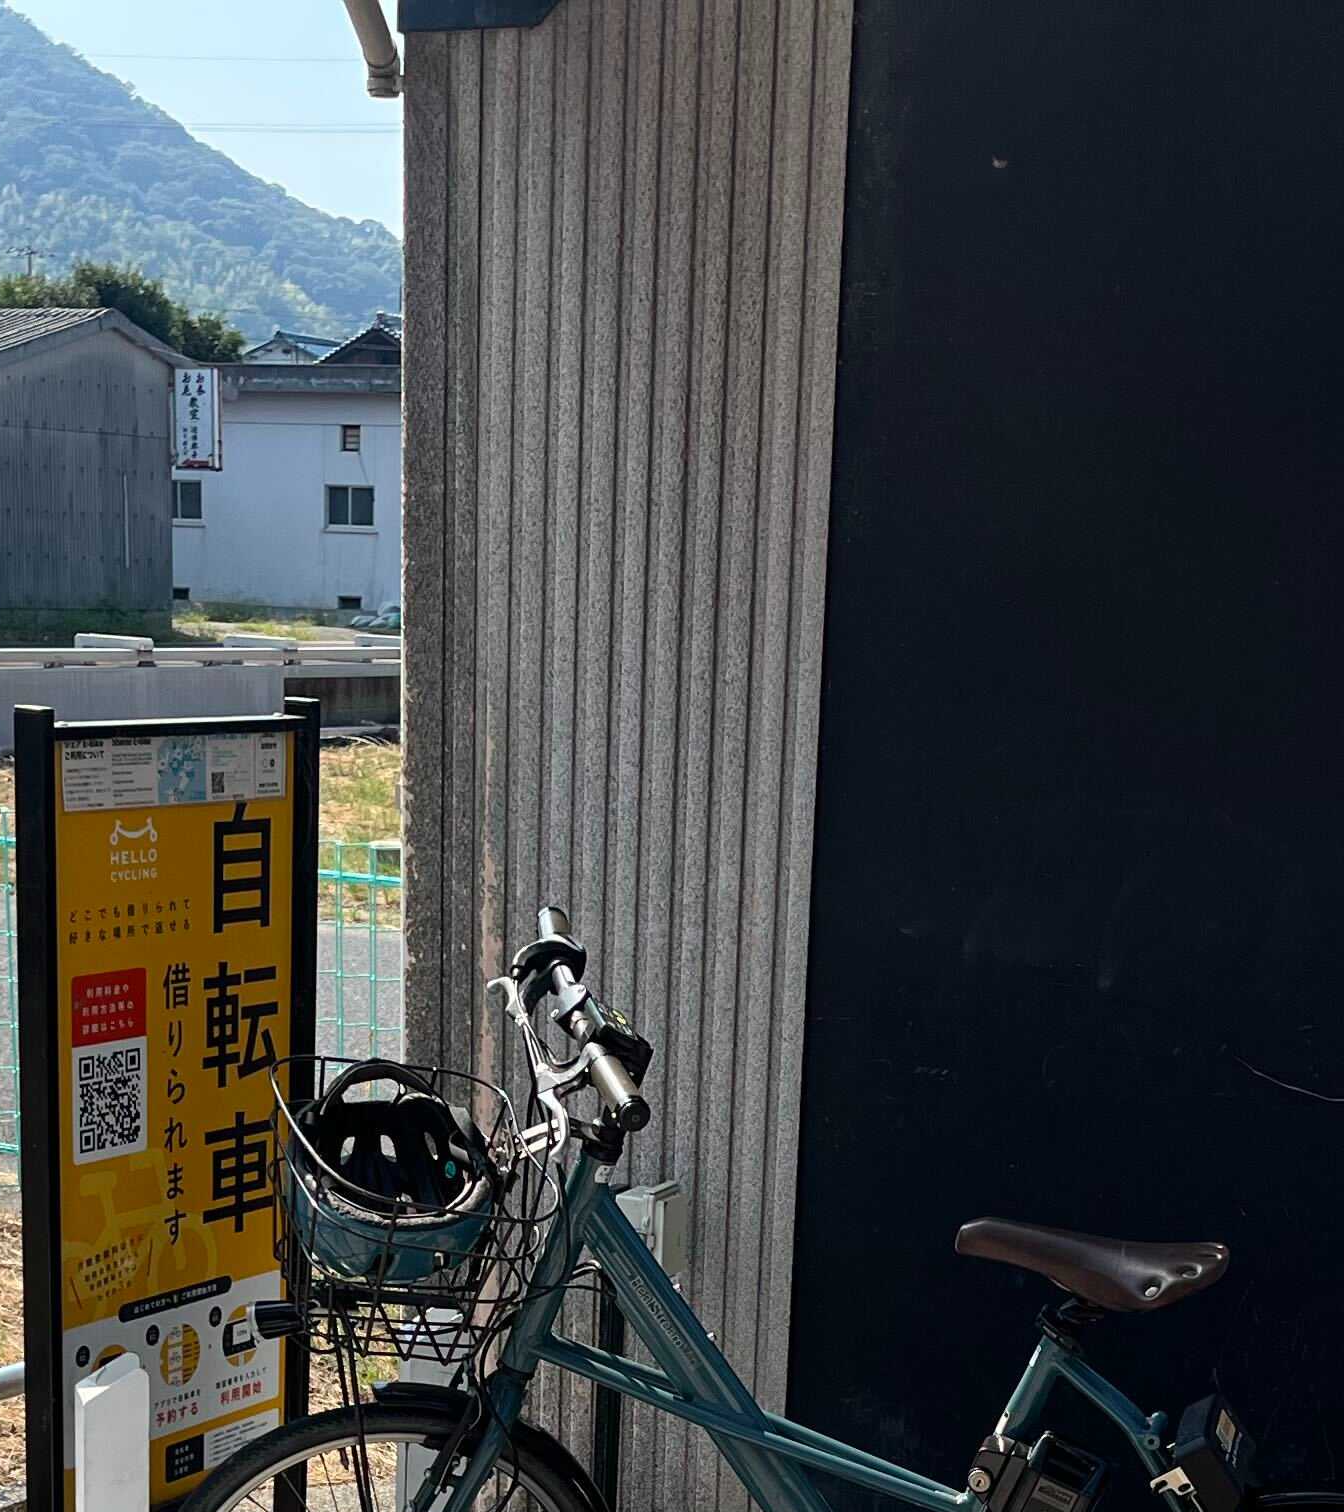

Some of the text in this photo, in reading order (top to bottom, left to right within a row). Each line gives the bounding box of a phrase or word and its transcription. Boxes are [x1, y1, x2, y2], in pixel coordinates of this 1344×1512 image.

[109, 848, 158, 865] HELLO
[109, 867, 158, 882] CYCLING
[68, 898, 191, 923] どこでも借りられて
[202, 801, 280, 1233] 自転車
[162, 961, 191, 1246] 借りられます
[631, 1275, 683, 1349] RealStream
[219, 1380, 263, 1405] 利用開始
[155, 1402, 200, 1427] 予約する
